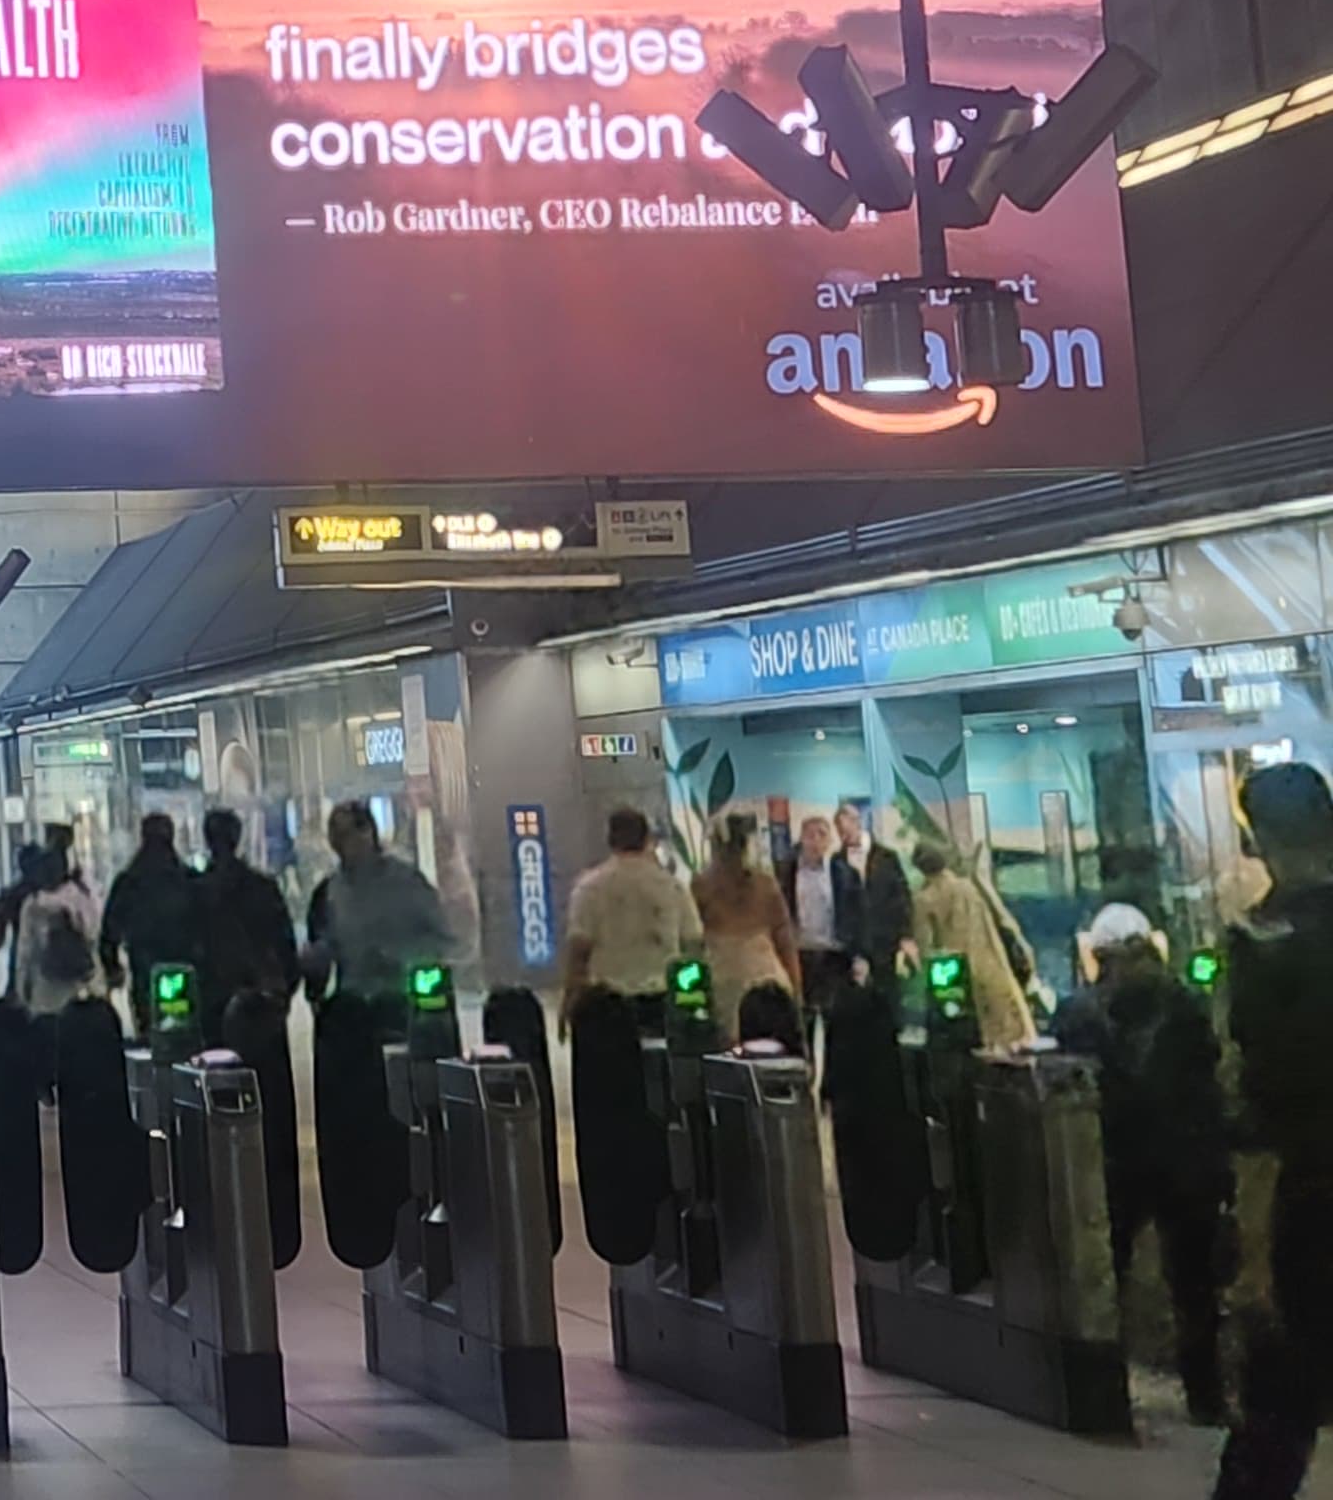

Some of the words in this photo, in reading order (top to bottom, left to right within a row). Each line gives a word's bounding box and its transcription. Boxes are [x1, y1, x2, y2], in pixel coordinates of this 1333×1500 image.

[264, 21, 450, 90] finally
[463, 15, 706, 87] bridges
[269, 105, 687, 170] conservation
[324, 201, 385, 235] Rob
[393, 198, 532, 235] Gardner,
[539, 198, 611, 230] CEO
[620, 194, 781, 229] Rebalance
[764, 325, 1105, 395] amaon
[312, 515, 360, 542] Way
[363, 517, 403, 539] out
[749, 633, 798, 679] SHOP
[801, 631, 817, 670] &
[818, 619, 860, 672] DINE
[880, 619, 931, 653] CANADA
[929, 614, 970, 646] PLACE
